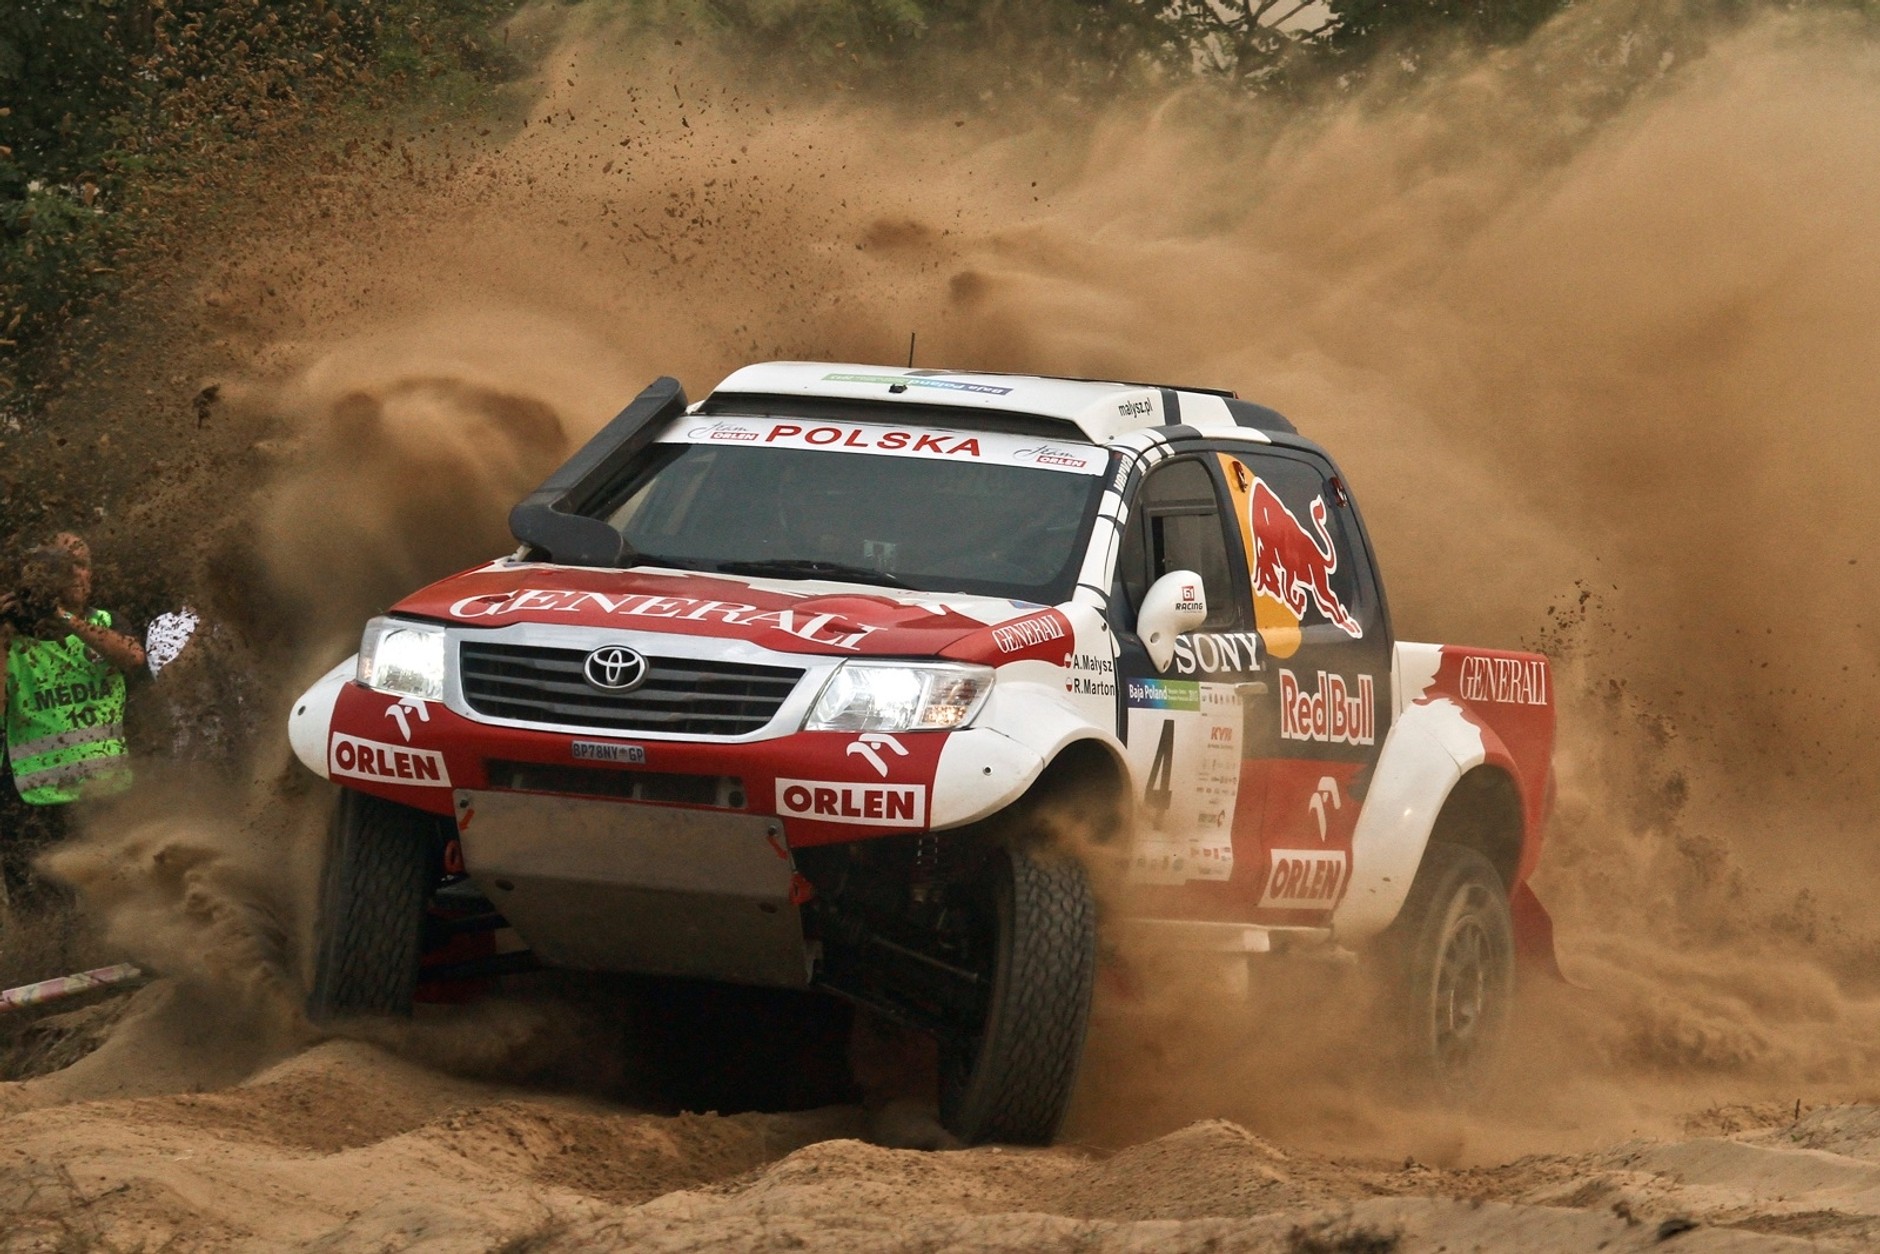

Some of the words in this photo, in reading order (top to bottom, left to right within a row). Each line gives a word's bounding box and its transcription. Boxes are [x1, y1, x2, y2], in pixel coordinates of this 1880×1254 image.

[713, 432, 753, 440] ORLEN
[765, 425, 982, 457] POLSKA
[1038, 455, 1082, 468] ORLEN
[449, 588, 888, 651] GENERALI
[1175, 602, 1204, 610] RACING
[992, 614, 1064, 653] GENERALI
[1174, 633, 1261, 674] SONY
[34, 679, 113, 711] MEDIA
[1074, 678, 1115, 696] R.Marton
[1129, 684, 1144, 702] Baja
[1144, 684, 1167, 699] Poland
[1460, 656, 1547, 705] GENERALI
[335, 740, 441, 781] ORLEN
[1144, 719, 1175, 830] 4
[783, 785, 915, 820] ORLEN
[1269, 858, 1342, 900] ORLEN
